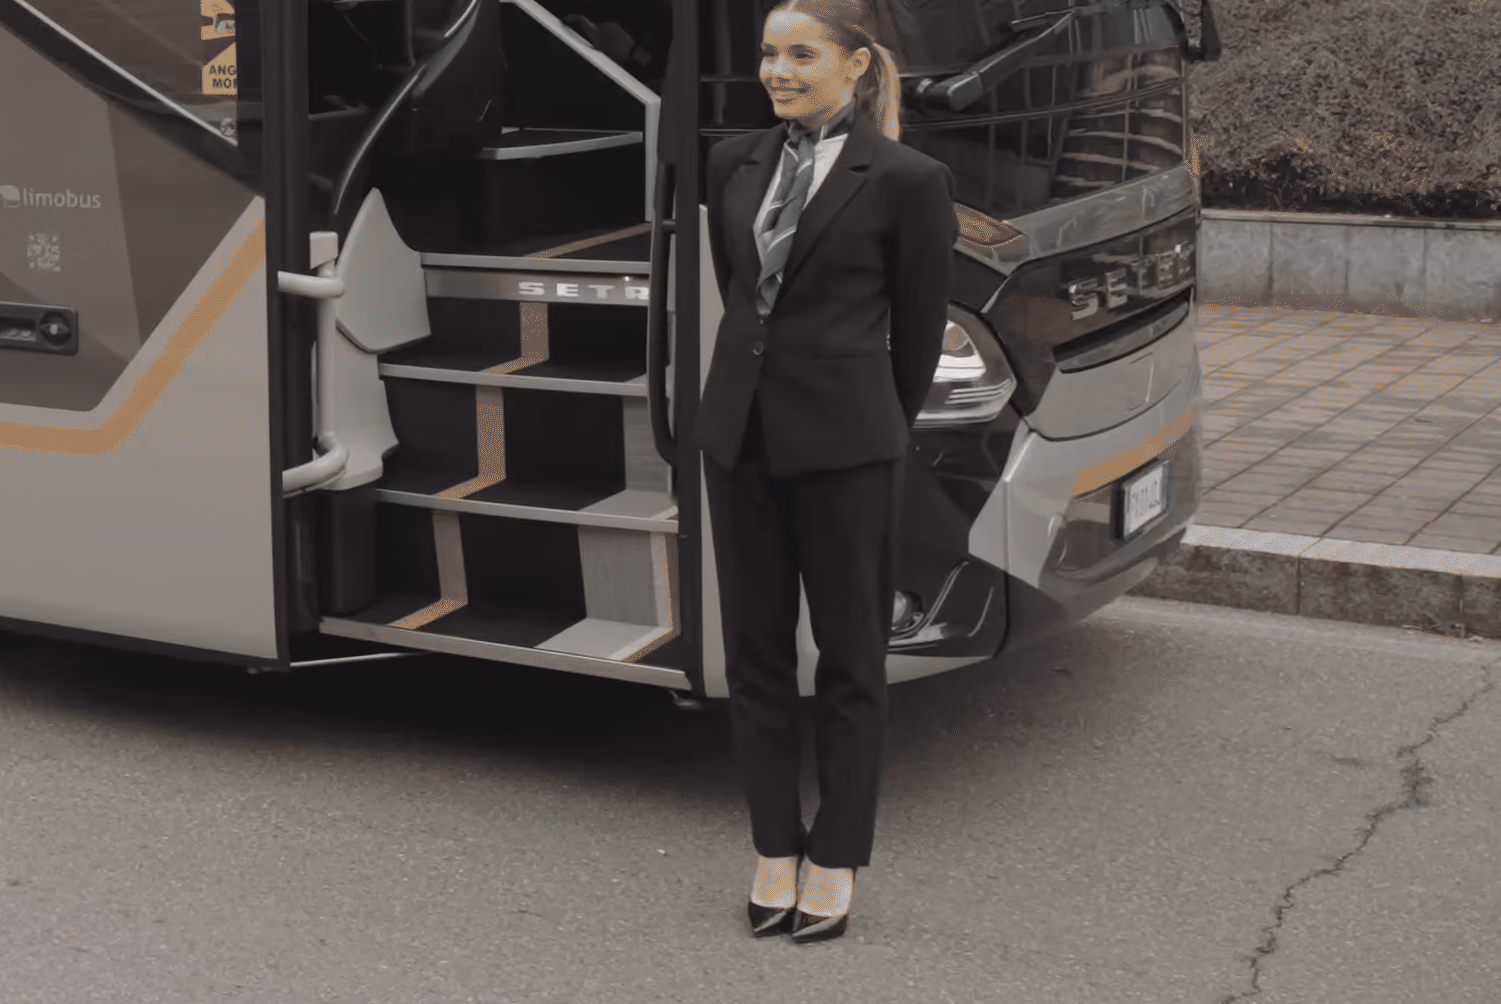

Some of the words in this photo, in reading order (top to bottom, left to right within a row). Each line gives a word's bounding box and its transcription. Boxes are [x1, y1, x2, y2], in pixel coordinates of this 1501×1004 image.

[209, 64, 237, 76] ANG
[23, 187, 102, 209] limobus
[518, 281, 649, 300] SETR
